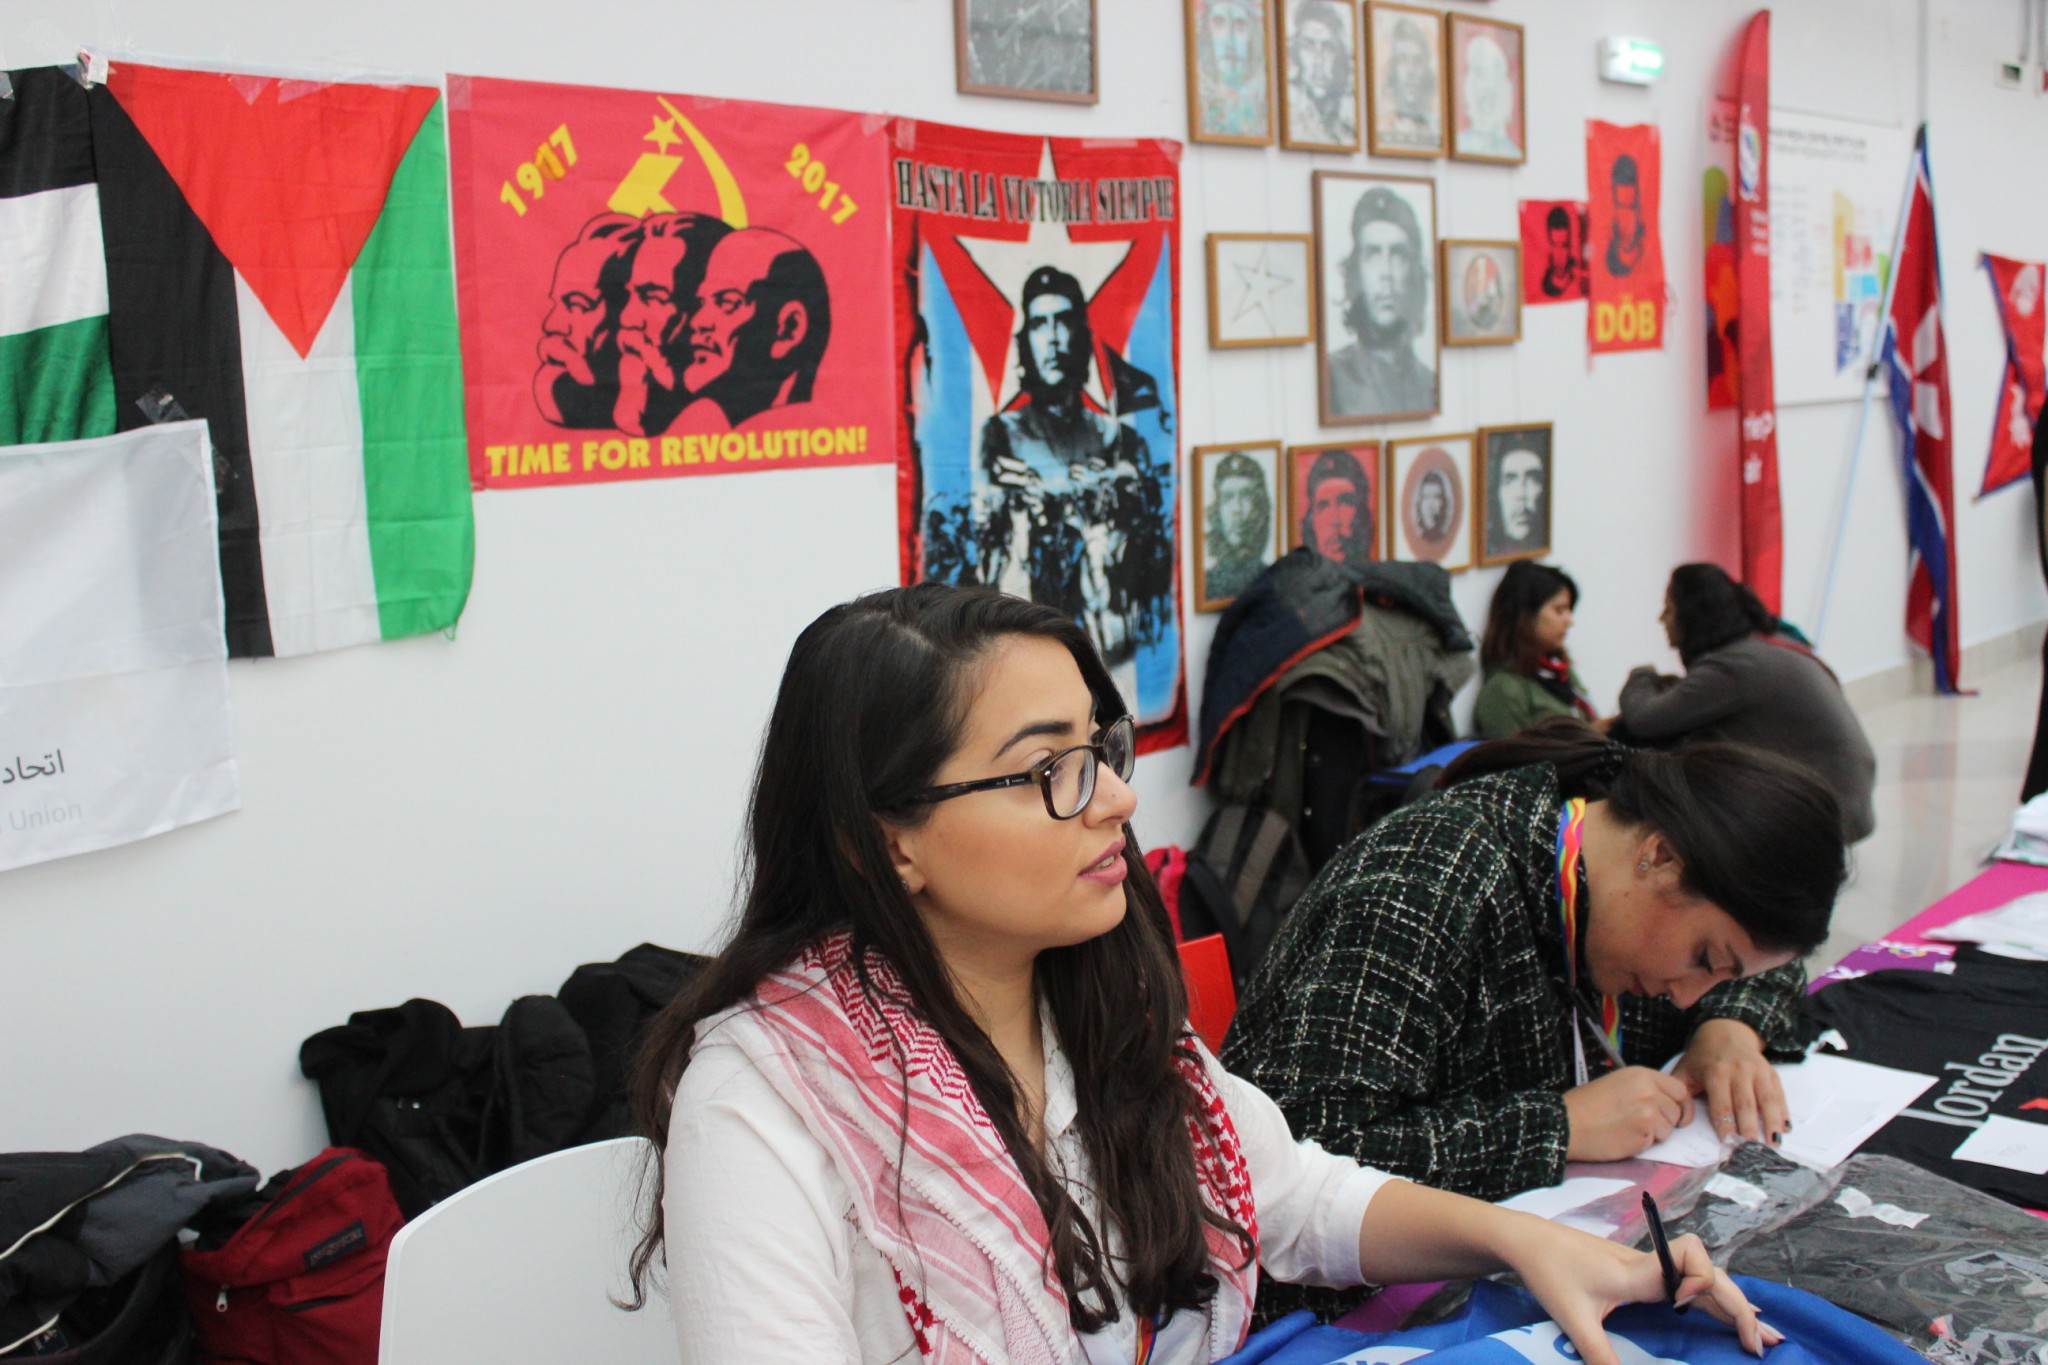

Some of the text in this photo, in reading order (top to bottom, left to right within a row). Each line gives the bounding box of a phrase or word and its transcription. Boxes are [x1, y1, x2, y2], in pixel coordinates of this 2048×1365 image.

[500, 122, 577, 217] 1917
[784, 143, 858, 225] 2017
[896, 159, 968, 216] HASTA
[971, 172, 998, 220] LA
[1096, 176, 1175, 225] SIEMPE
[1595, 293, 1656, 342] DÖB
[485, 427, 867, 477] TIME FOR REVOLUTION!
[2, 748, 65, 785] اتحاد
[8, 803, 82, 831] Union
